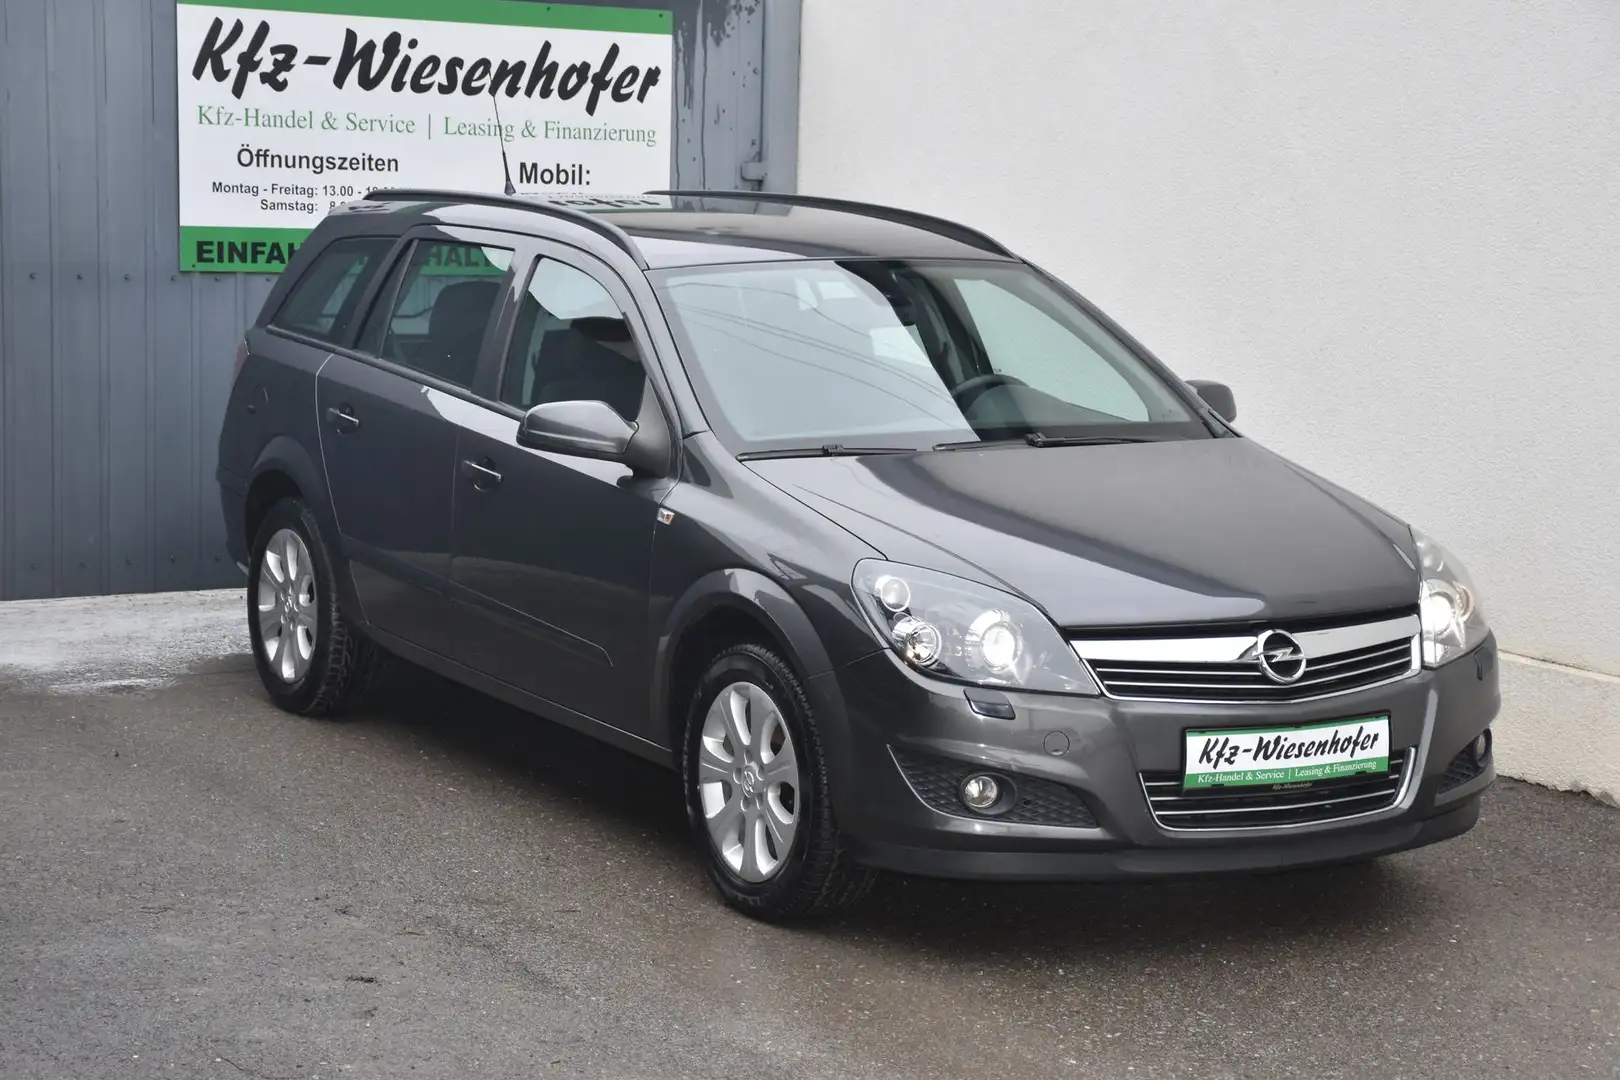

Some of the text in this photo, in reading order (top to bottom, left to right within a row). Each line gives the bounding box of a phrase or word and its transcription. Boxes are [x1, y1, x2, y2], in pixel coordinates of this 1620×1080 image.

[192, 16, 662, 116] Kfz-Wiesenhofer
[198, 105, 313, 129] Kfz-Handel
[321, 111, 338, 130] &
[346, 112, 416, 133] Service
[444, 116, 515, 142] Leasing
[521, 119, 538, 138] &
[544, 120, 657, 147] Finanzierung
[237, 143, 399, 174] Öffnungszeiten
[519, 162, 591, 186] Mobil:
[212, 181, 259, 196] Montag
[271, 184, 318, 199] Freitag:
[322, 186, 354, 197] 13.00
[260, 199, 318, 214] Samstag:
[1198, 725, 1379, 770] Kfz-Wiesenhofer
[1198, 772, 1244, 783] Kfz-Handel
[1245, 771, 1253, 780] &
[1255, 770, 1285, 780] Service
[1295, 766, 1323, 777] Leasing
[1324, 765, 1331, 774] &
[1333, 760, 1377, 773] Finanzierung
